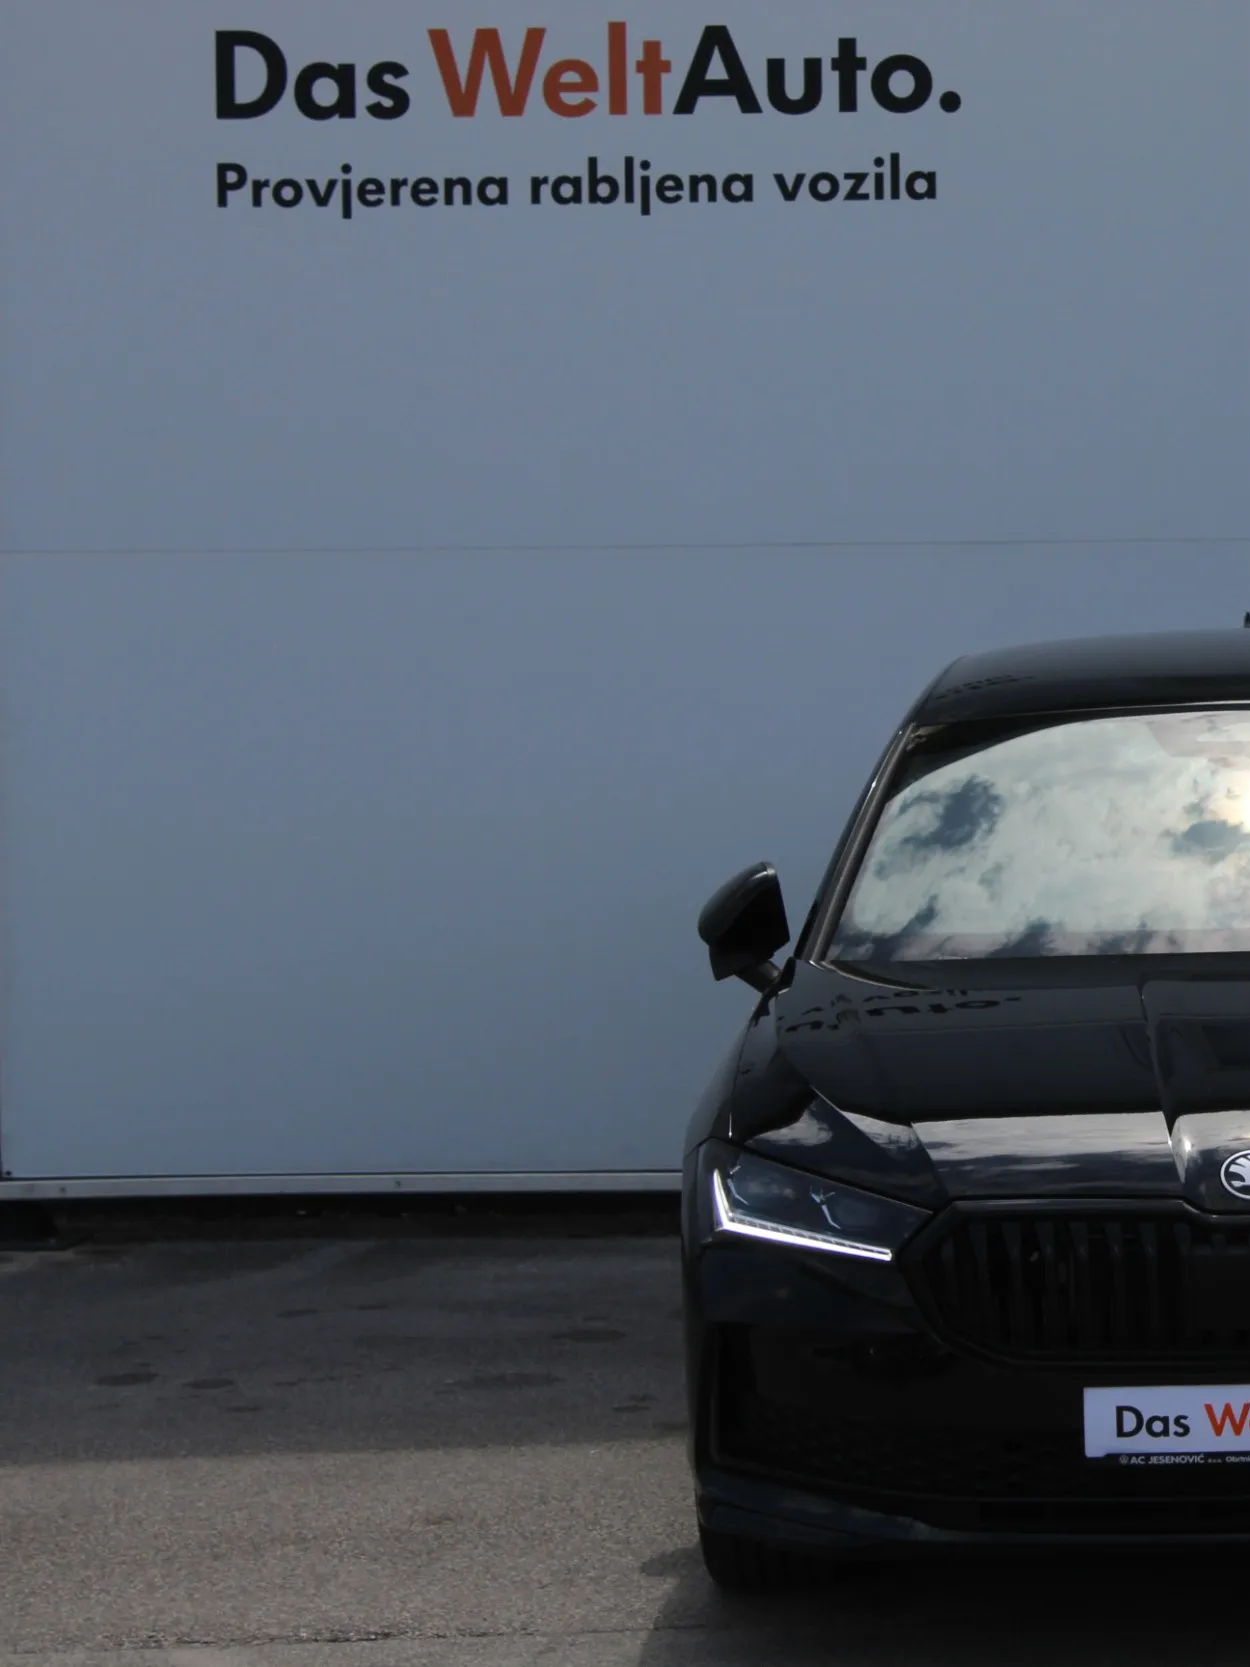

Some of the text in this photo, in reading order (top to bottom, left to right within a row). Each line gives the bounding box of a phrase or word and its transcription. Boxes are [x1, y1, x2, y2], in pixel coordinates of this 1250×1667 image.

[215, 21, 962, 121] Das WeltAuto.
[216, 152, 937, 220] Provjerena rabljena vozila
[1115, 1405, 1191, 1438] Das
[1130, 1456, 1146, 1465] AC
[1148, 1453, 1206, 1465] JESENOVIĆ
